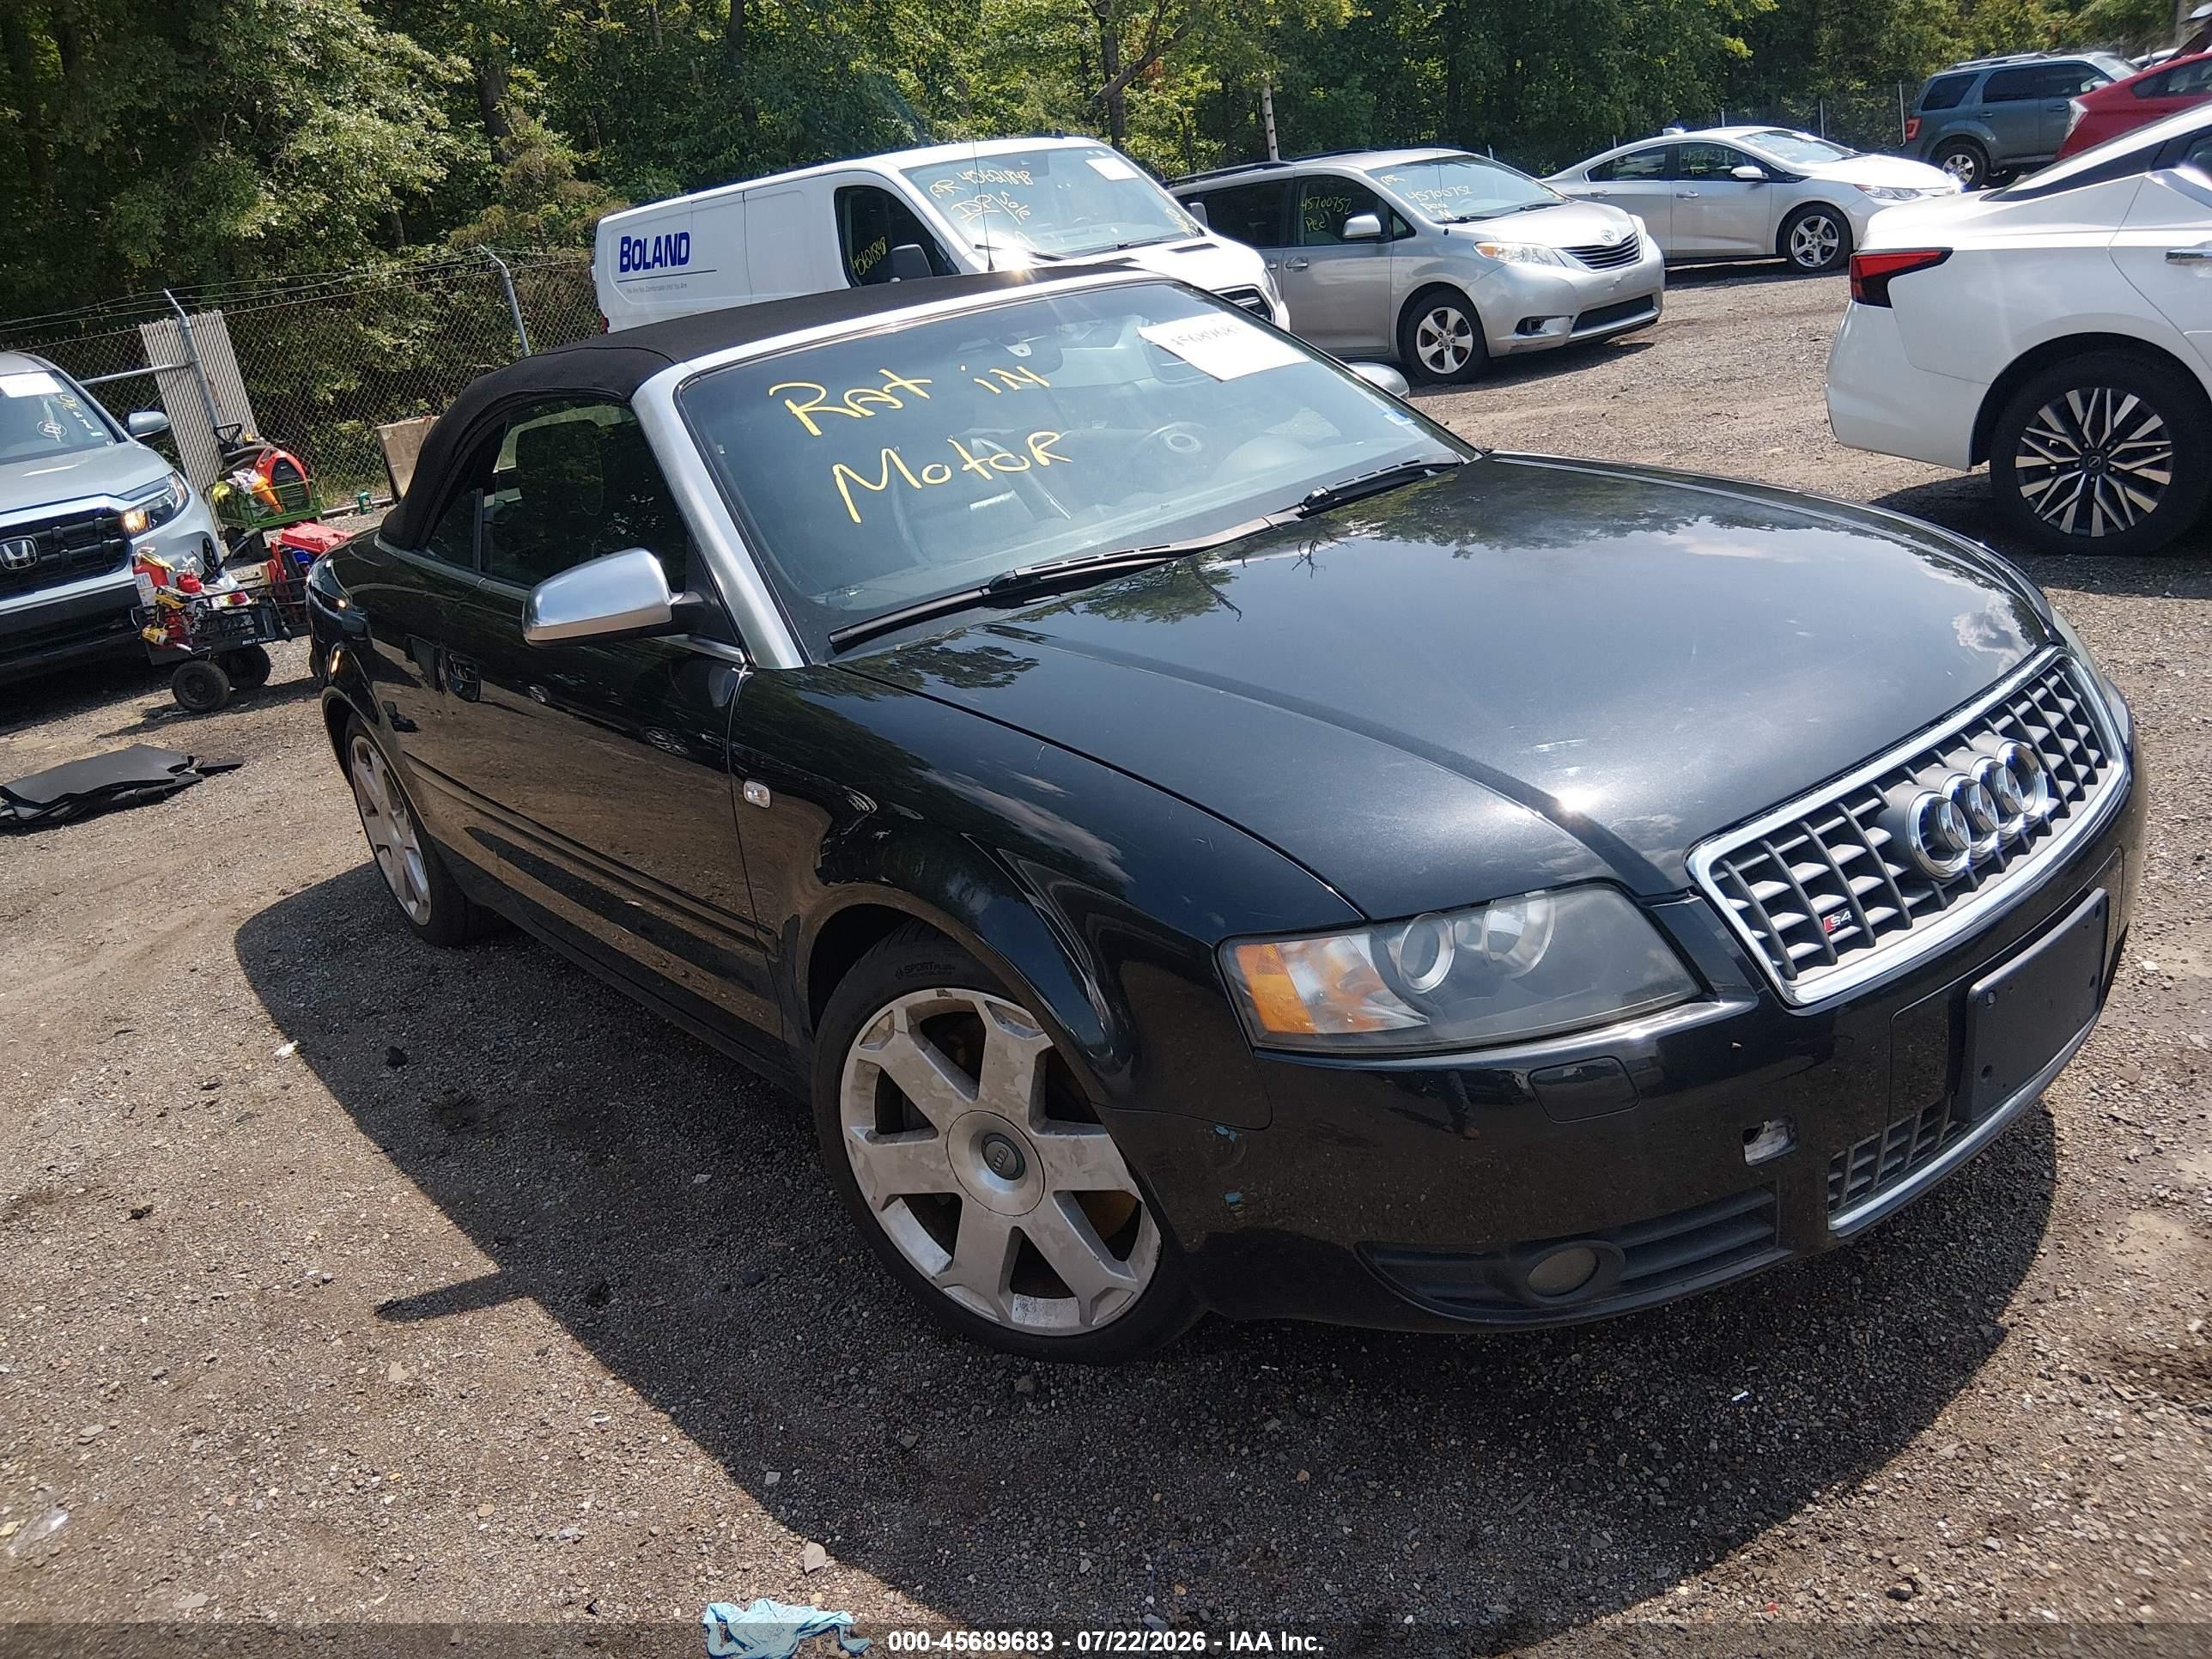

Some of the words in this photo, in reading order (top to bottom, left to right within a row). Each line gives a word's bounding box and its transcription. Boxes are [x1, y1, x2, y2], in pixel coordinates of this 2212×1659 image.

[1404, 185, 1473, 203] 45700752
[1301, 196, 1354, 216] 45700752
[619, 231, 690, 273] BOLAND
[1830, 909, 1853, 927] S4
[904, 961, 935, 975] SPORT
